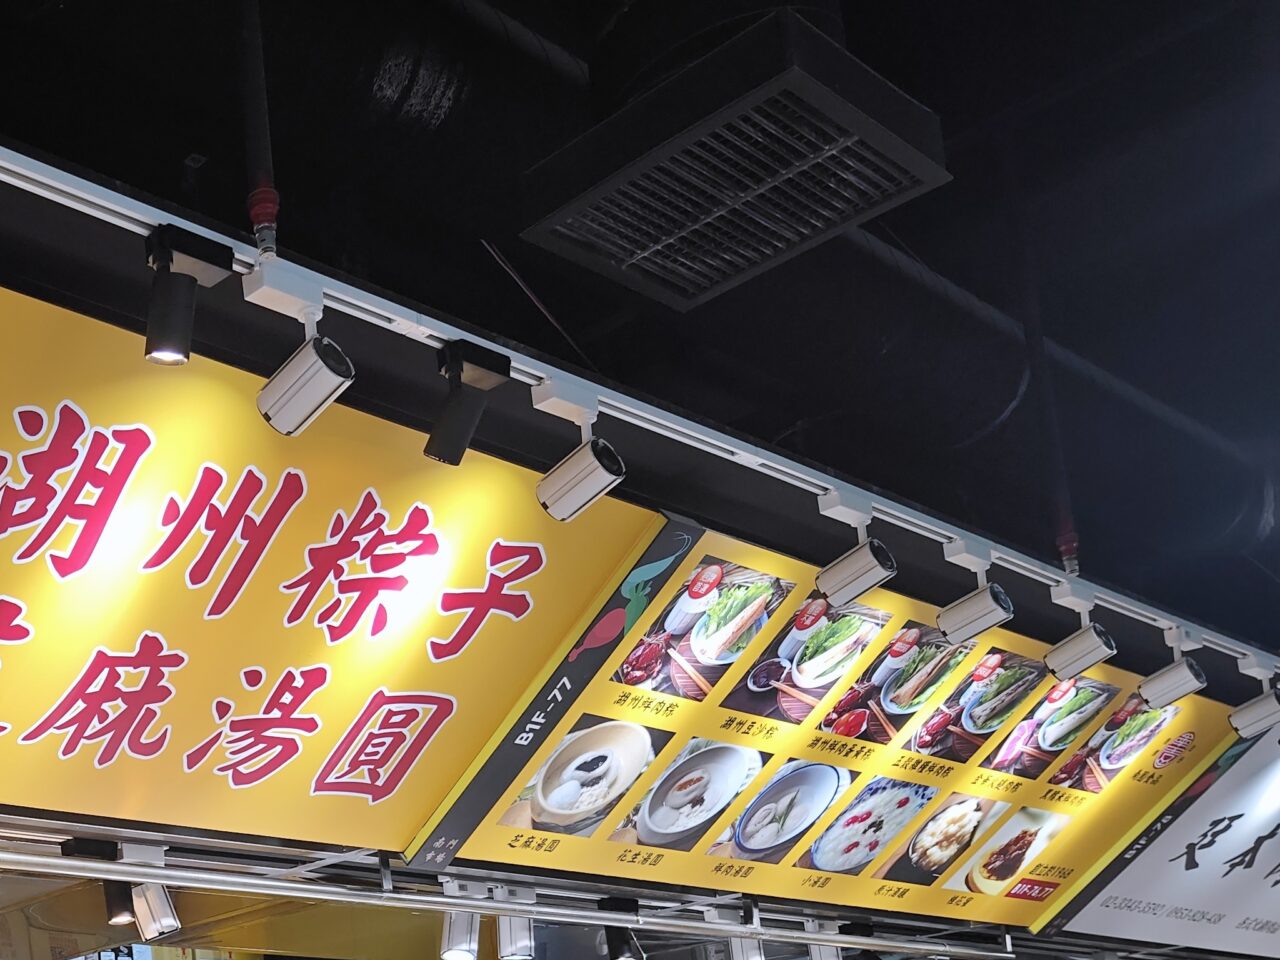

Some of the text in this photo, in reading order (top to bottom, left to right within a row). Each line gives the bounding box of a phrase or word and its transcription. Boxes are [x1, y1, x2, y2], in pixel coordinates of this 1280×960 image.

[514, 677, 573, 746] B1F-77
[614, 691, 679, 717] 湖州鮮肉粽
[720, 716, 778, 740] 湖州豆沙粽
[507, 834, 560, 853] 芝麻湯圓
[617, 849, 664, 866] 花生湯圓
[712, 862, 755, 878] 鮮肉湯圓
[801, 875, 832, 888] 小湯圓
